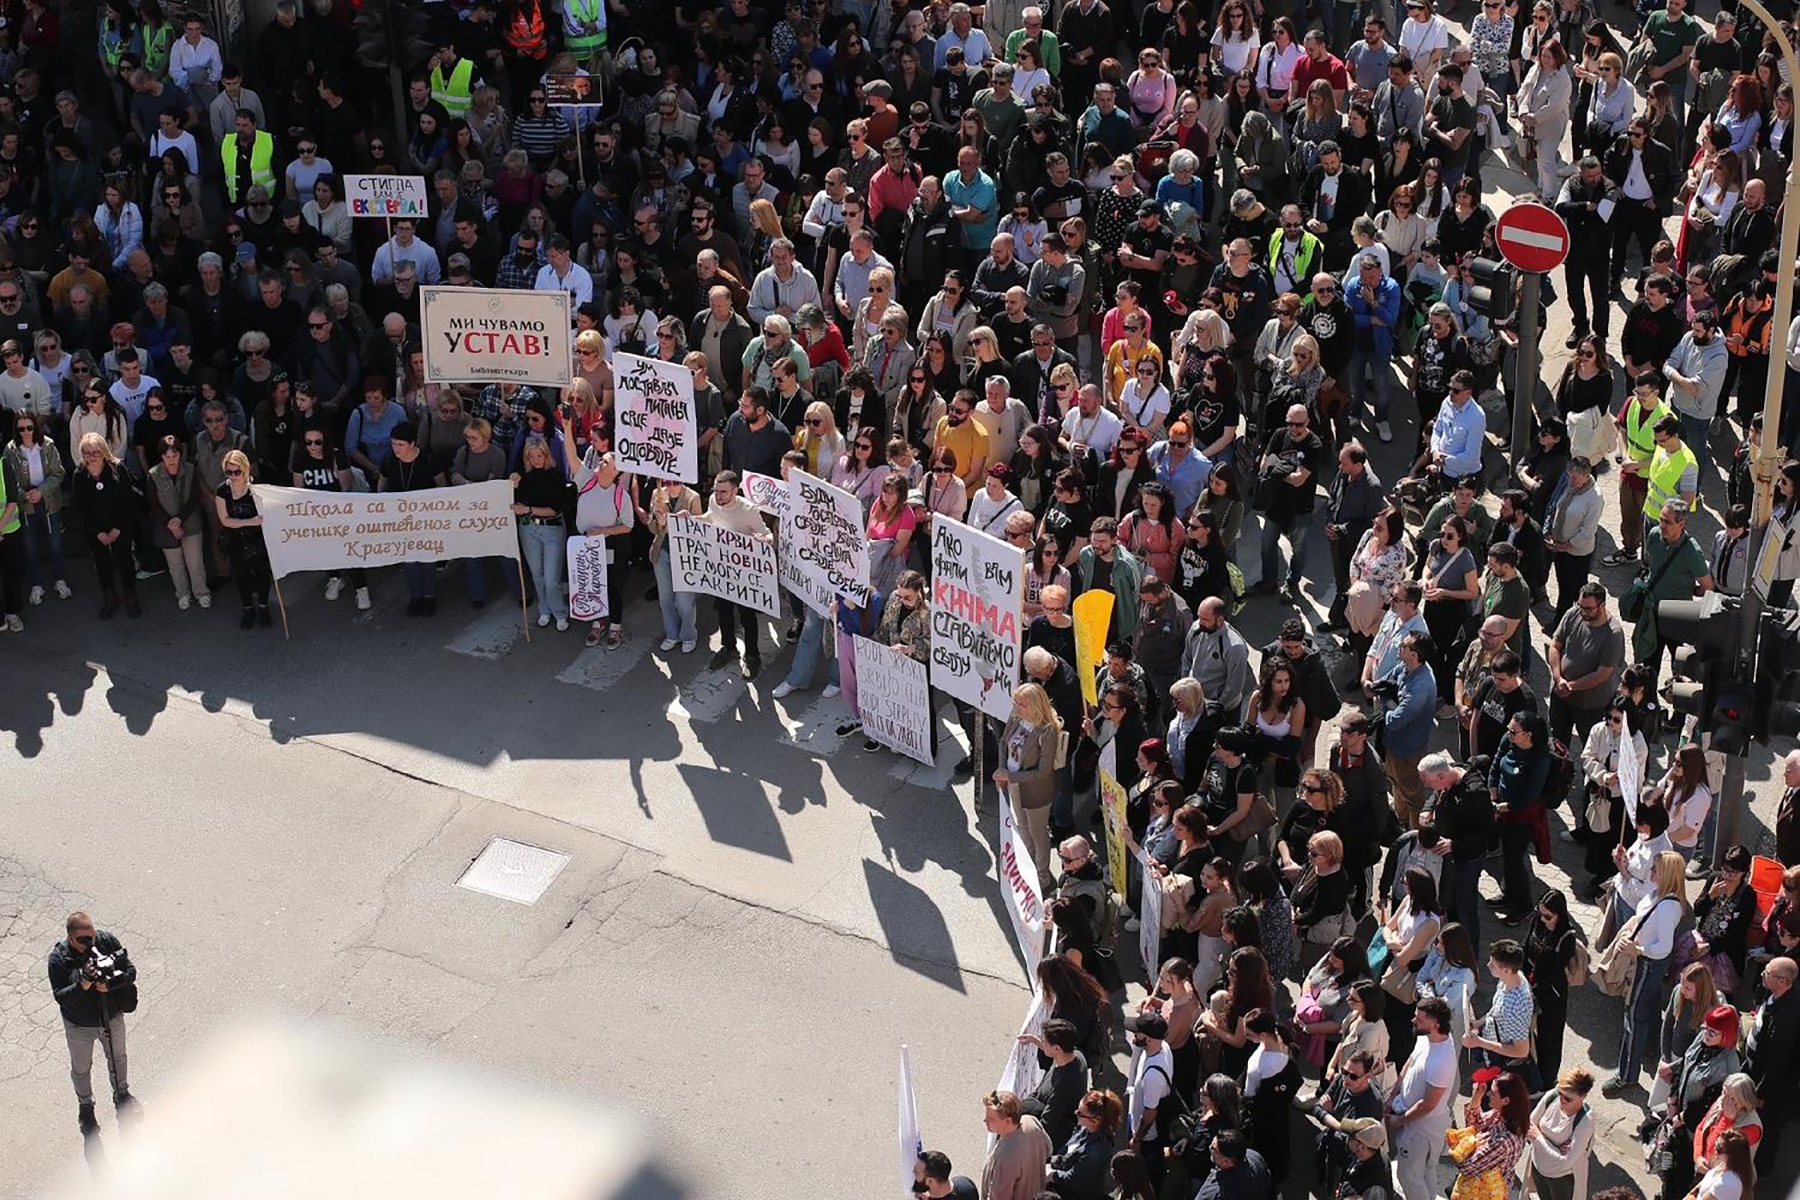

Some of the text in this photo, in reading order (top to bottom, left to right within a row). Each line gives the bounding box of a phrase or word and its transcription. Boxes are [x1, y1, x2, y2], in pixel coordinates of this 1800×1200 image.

[358, 178, 414, 192] СТИГЛА
[449, 317, 545, 333] МИ ЧУВАМО
[443, 331, 550, 357] УСТАВ!
[621, 410, 648, 431] СРЦЕ
[286, 499, 489, 518] Школа са домом за
[281, 515, 510, 544] ученике оштећеног слуха
[669, 515, 711, 538] ТРАГ
[716, 527, 754, 553] КРВИ
[761, 541, 771, 558] И
[343, 538, 445, 561] Крагујевац
[673, 535, 712, 557] ТРАГ
[720, 546, 774, 576] НОВЦА
[680, 555, 702, 572] НЕ
[705, 559, 742, 581] МОГУ
[683, 571, 774, 610] САКРИТИ
